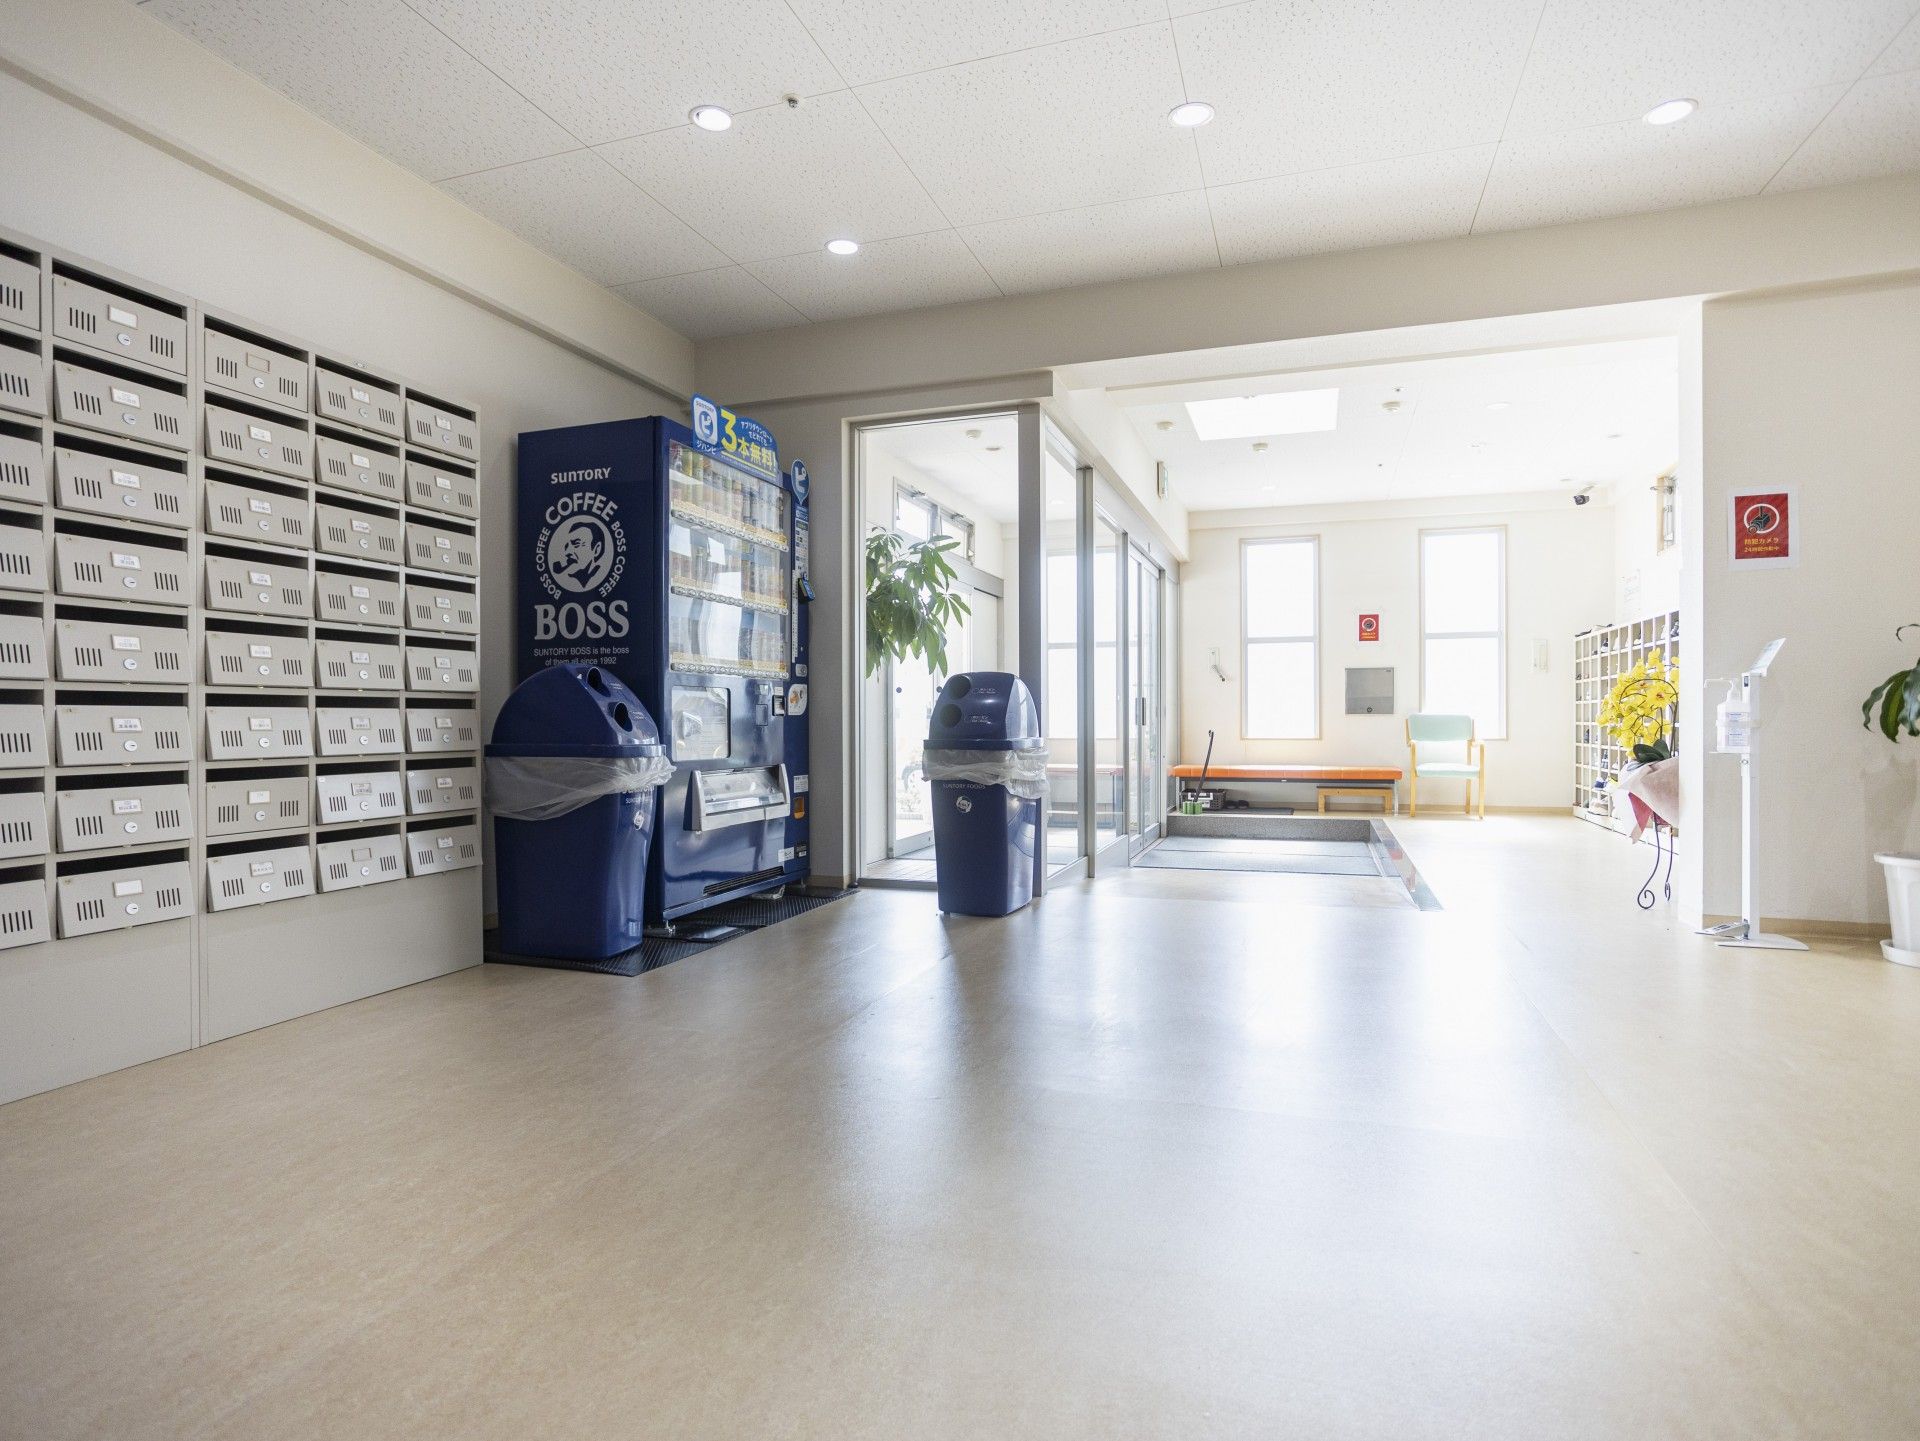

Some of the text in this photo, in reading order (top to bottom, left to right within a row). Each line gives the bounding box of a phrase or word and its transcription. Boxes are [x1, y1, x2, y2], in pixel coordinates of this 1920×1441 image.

[550, 467, 612, 485] SUNTORY
[545, 492, 618, 525] COFFEE
[1744, 537, 1779, 545] 防犯カメラ
[535, 527, 562, 600] BOSS COFFEE
[599, 520, 627, 598] BOSS COFFEE
[534, 600, 630, 640] BOSS
[533, 646, 630, 657] SUNTORY BOSS is the boss
[545, 658, 553, 667] of
[553, 658, 570, 666] them
[580, 657, 599, 666] since
[599, 656, 617, 665] 1992
